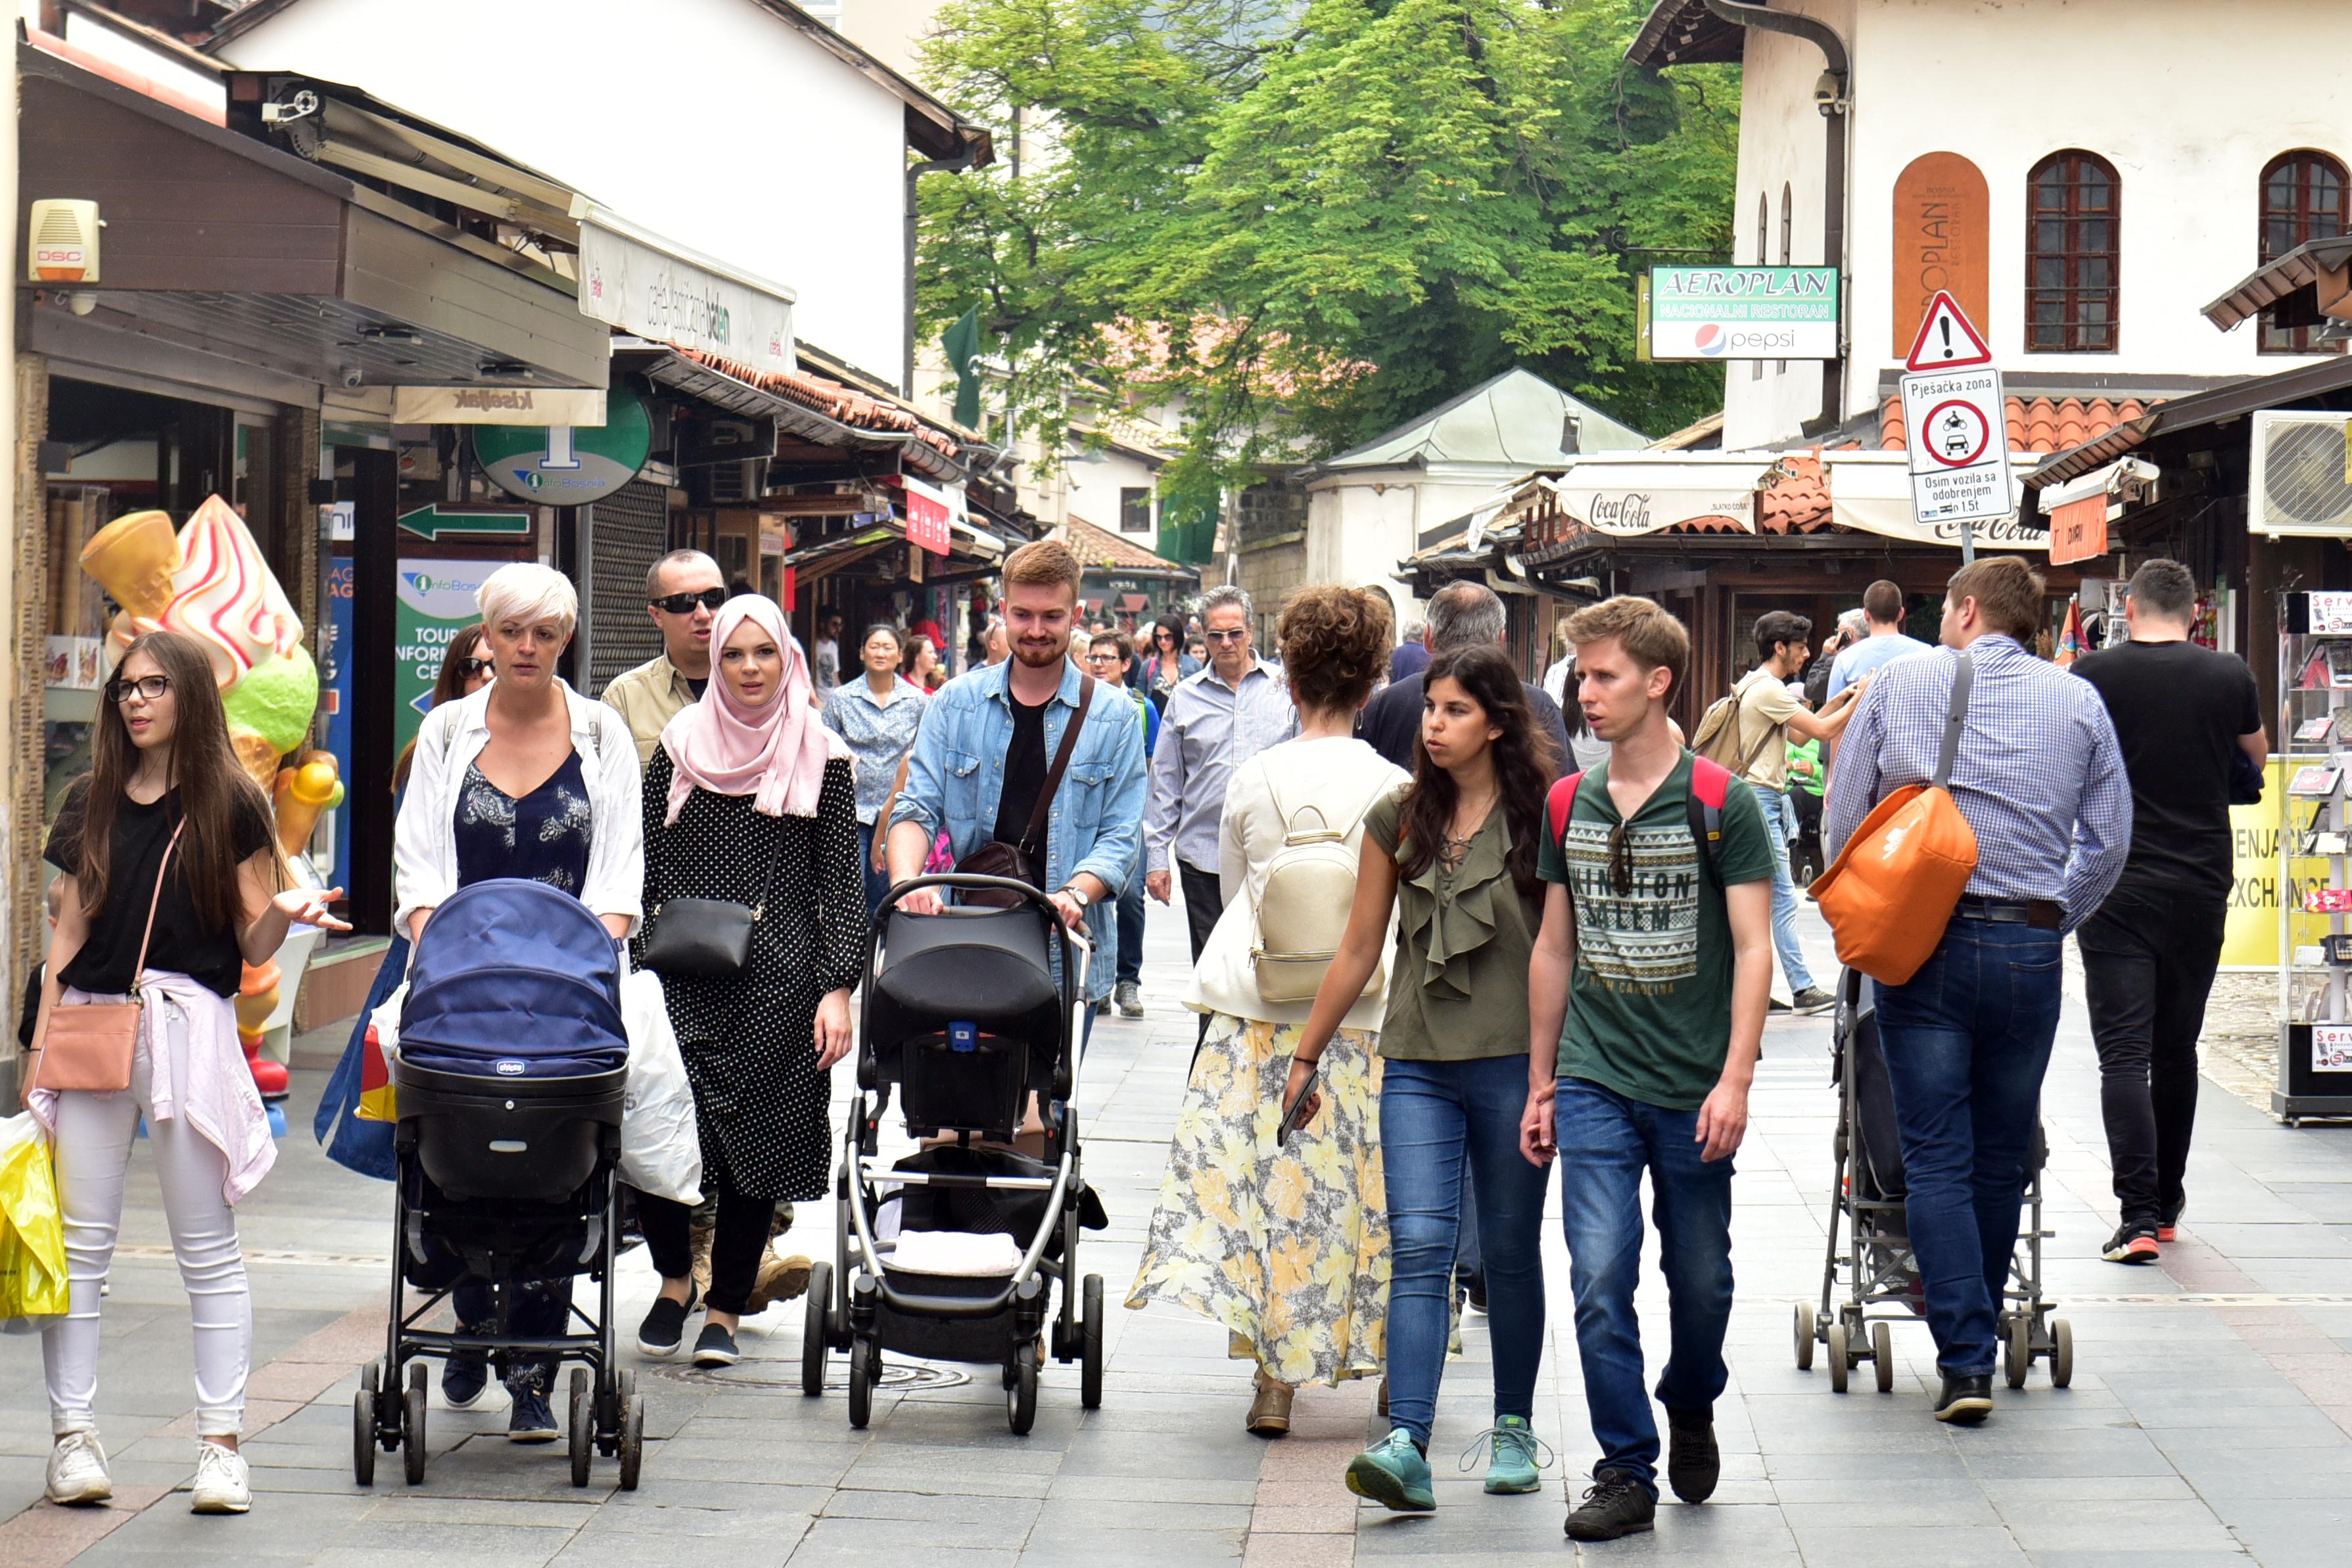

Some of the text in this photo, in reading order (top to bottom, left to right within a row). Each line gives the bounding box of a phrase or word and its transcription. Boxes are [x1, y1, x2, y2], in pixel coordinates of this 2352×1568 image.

[37, 251, 82, 262] DSC
[1921, 202, 1948, 321] OPLAN
[1658, 270, 1831, 296] AEROPLAN
[1660, 303, 1829, 319] NACIONALNI RESTORAN
[1731, 329, 1795, 351] pepsi
[1911, 379, 1992, 400] Pješačka zona
[1925, 473, 1996, 489] Osim vozila sa
[1933, 486, 1991, 501] odobrenjem
[1589, 493, 1651, 529] Coca-Cola
[1962, 500, 1980, 513] 1.5t
[330, 567, 354, 583] AG
[329, 583, 354, 599] AG
[395, 645, 448, 662] NFORM
[416, 664, 440, 680] CE
